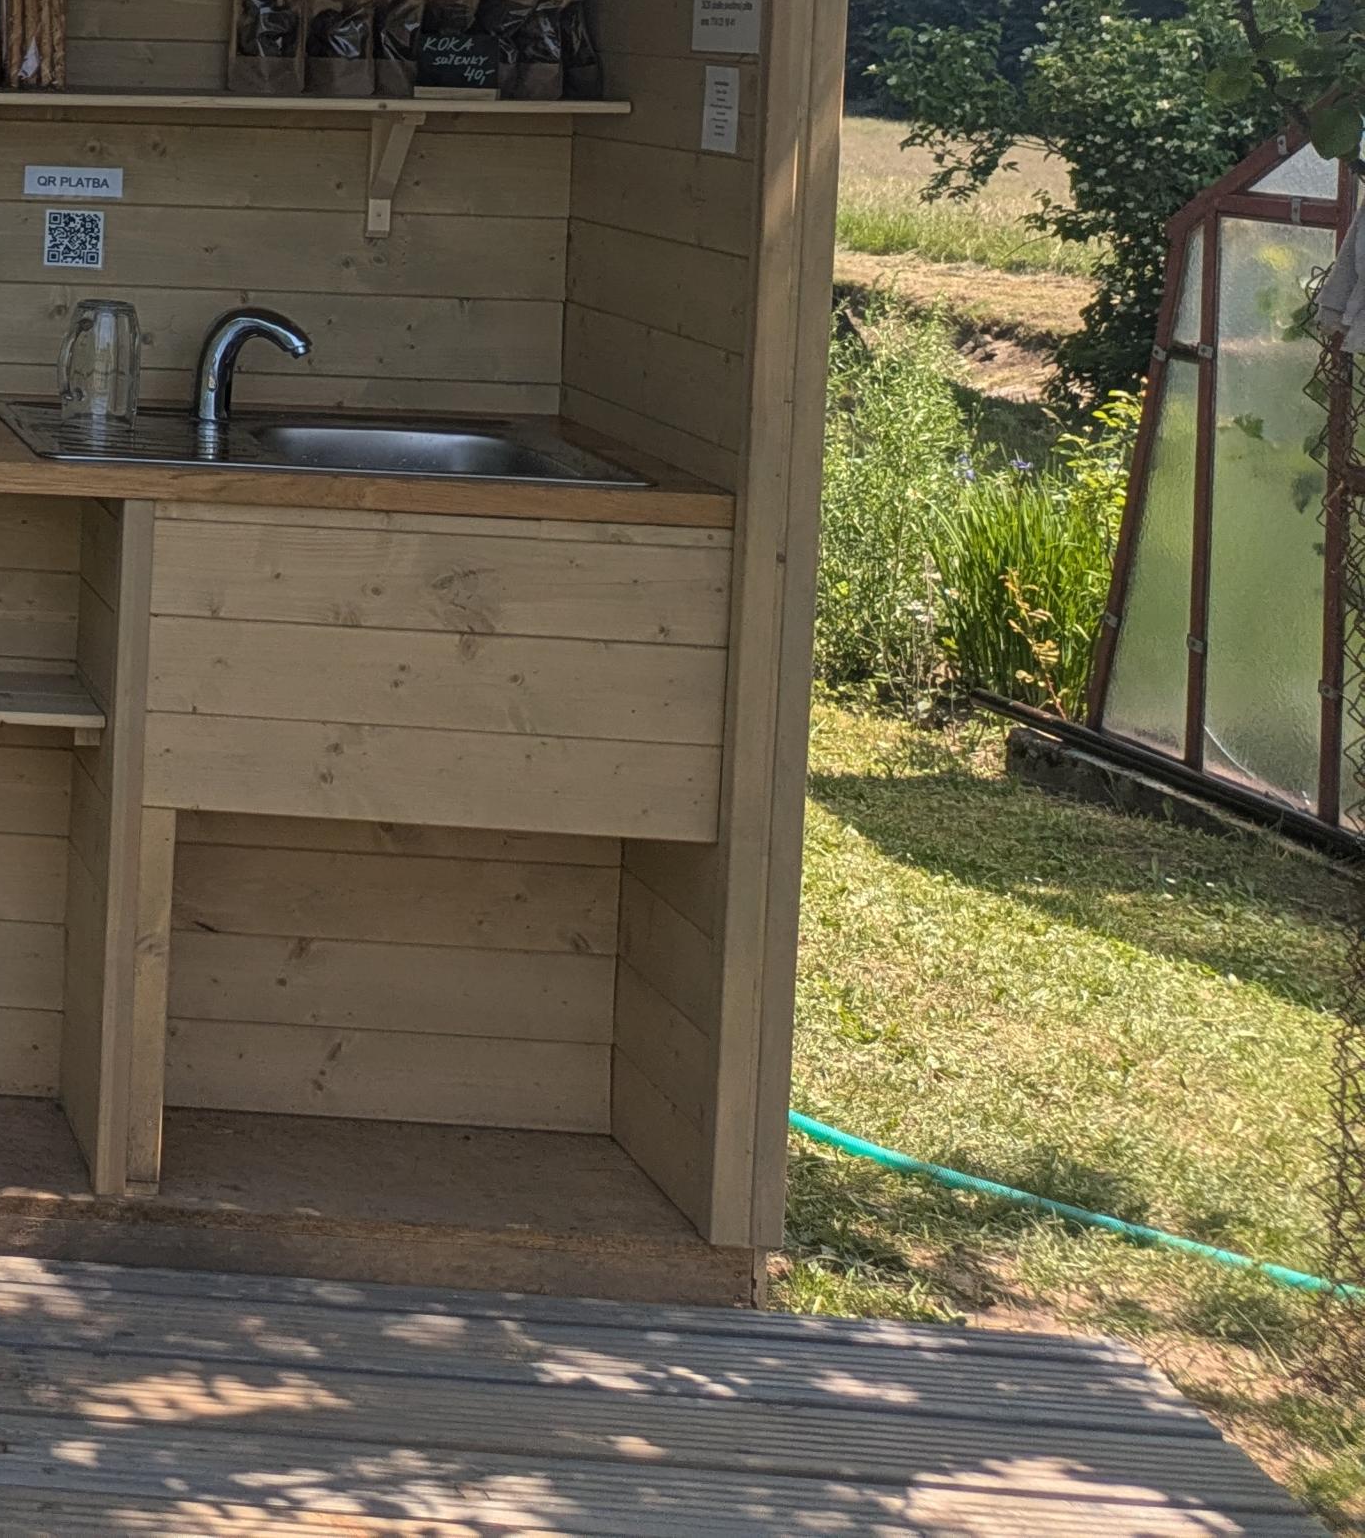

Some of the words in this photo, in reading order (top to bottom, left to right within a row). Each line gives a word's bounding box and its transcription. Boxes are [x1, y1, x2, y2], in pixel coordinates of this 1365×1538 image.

[422, 36, 475, 52] KOKA
[36, 174, 57, 188] QR
[59, 175, 110, 189] PLATBA
